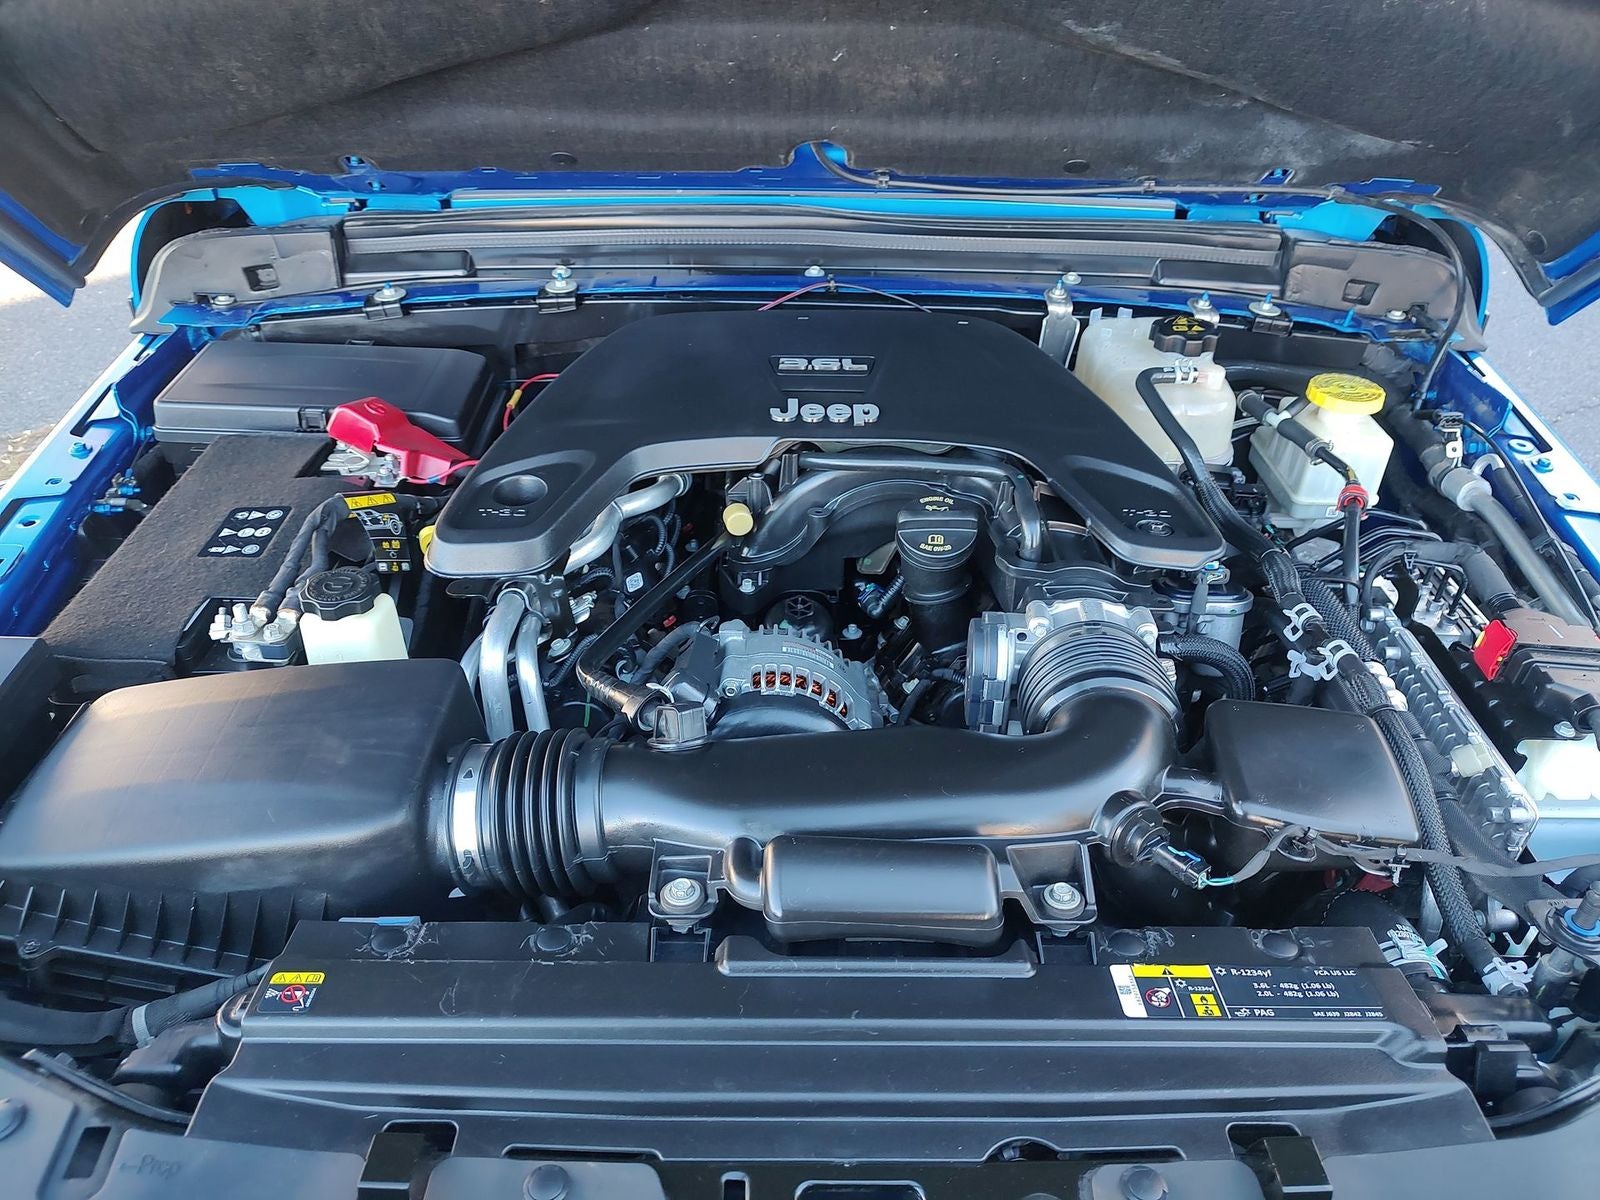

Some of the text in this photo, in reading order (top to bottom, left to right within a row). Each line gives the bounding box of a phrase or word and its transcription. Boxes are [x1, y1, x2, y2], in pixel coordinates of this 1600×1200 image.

[778, 357, 868, 371] 3.6L
[769, 398, 880, 426] Jeep
[919, 496, 944, 504] ENGINE
[1230, 969, 1272, 978] R-1234yf
[1252, 982, 1271, 990] 3.6L
[1279, 983, 1300, 991] 482g
[1256, 990, 1275, 998] 2.0L
[1283, 991, 1304, 999] 482g
[1253, 1008, 1275, 1017] PAG
